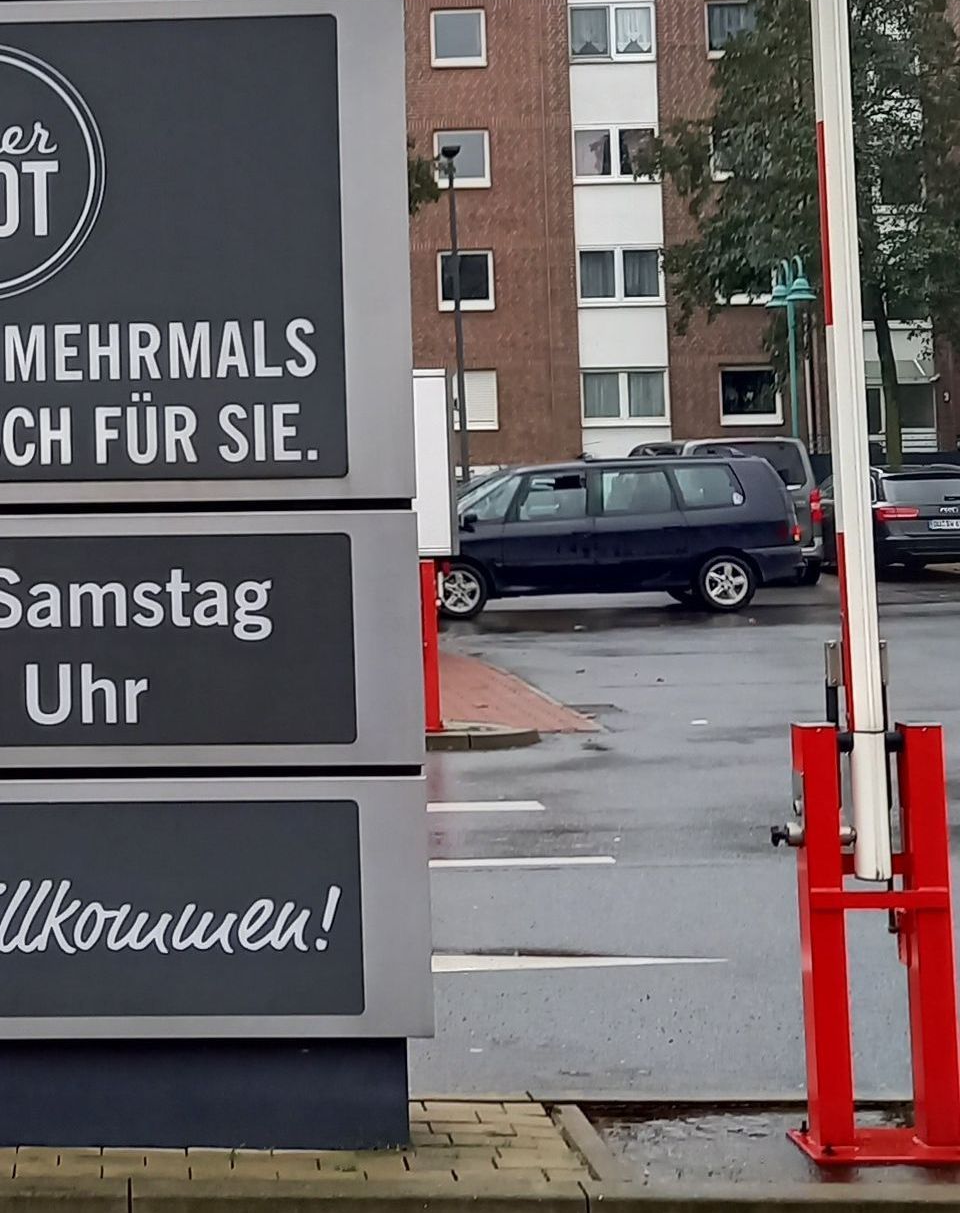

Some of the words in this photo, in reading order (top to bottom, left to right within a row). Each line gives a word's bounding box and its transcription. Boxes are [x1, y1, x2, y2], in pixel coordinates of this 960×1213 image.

[4, 318, 317, 382] MEHRMALS
[95, 392, 198, 464] FÜR
[218, 403, 318, 463] SIE.
[25, 662, 150, 725] Uhr
